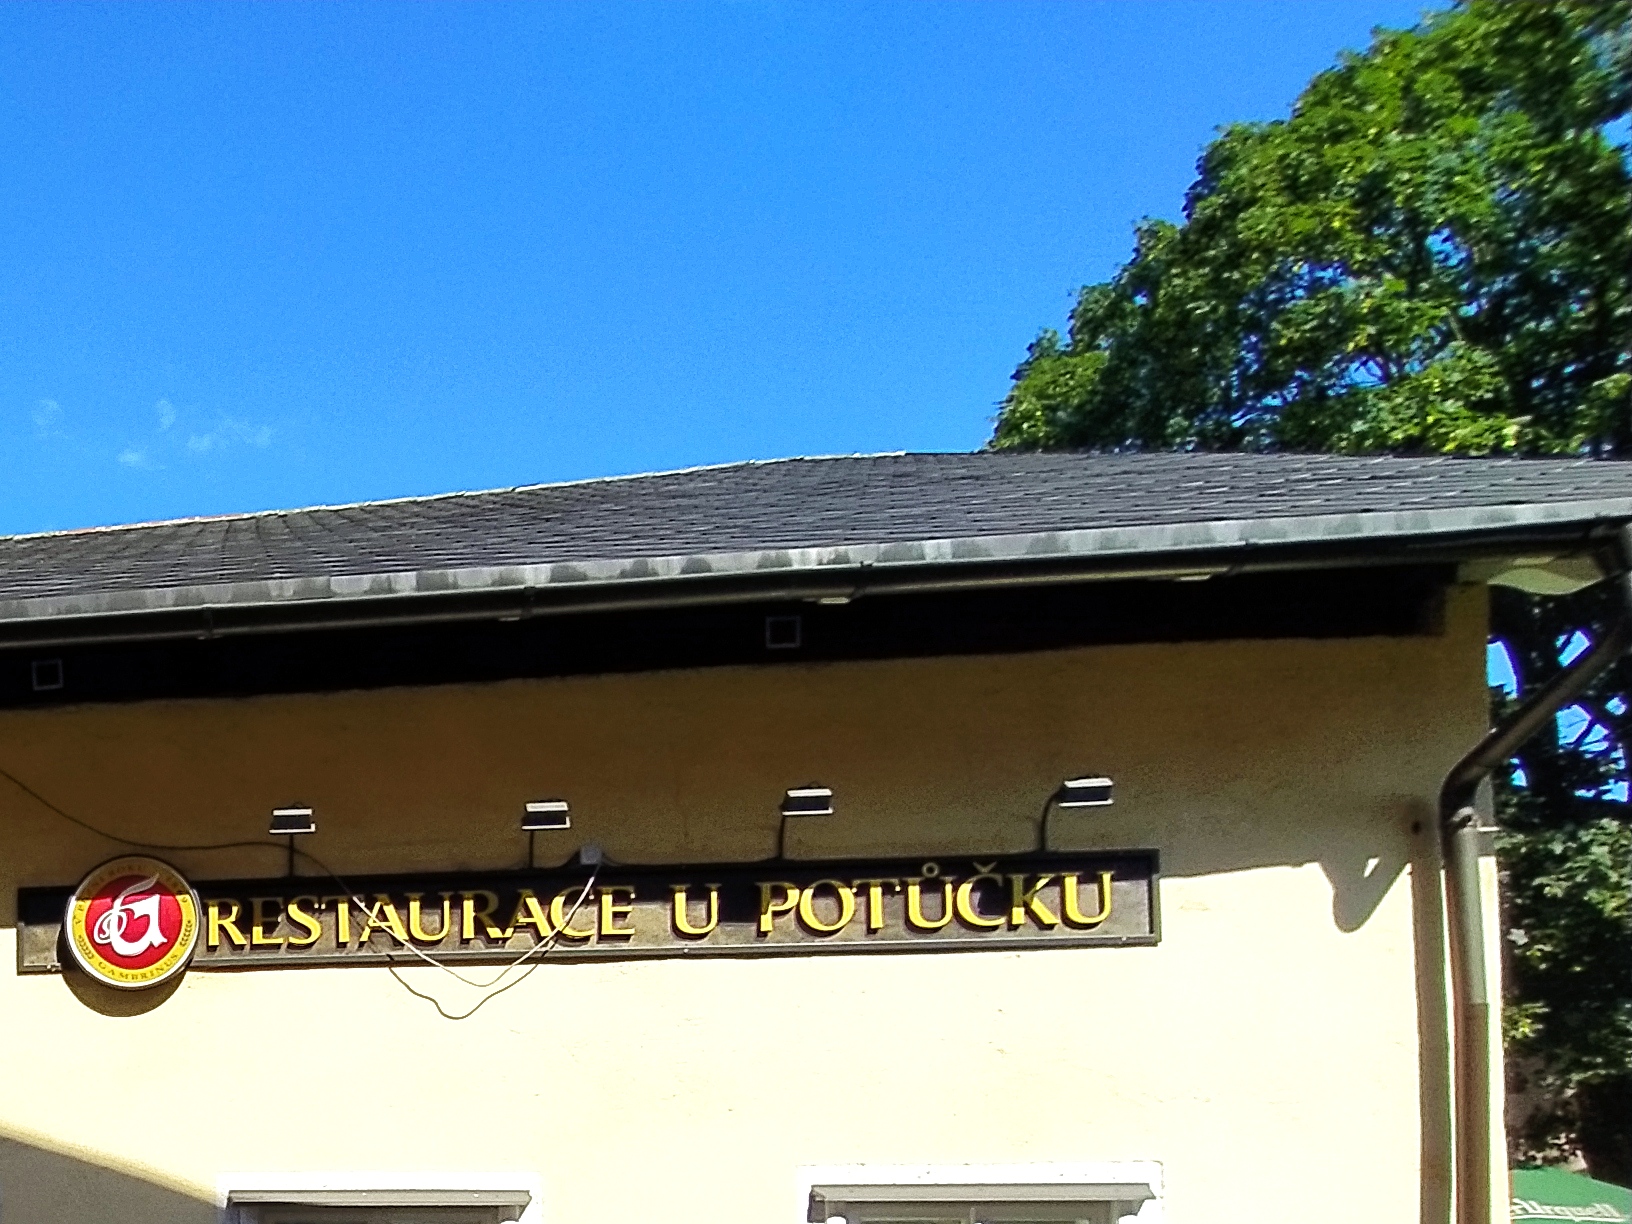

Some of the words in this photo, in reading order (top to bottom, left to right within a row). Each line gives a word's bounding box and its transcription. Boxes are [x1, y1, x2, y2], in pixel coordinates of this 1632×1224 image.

[204, 884, 637, 947] RESTAURACE
[670, 883, 722, 935] U
[756, 861, 1114, 932] POTŮČKU
[98, 954, 178, 980] GAMBRINUS
